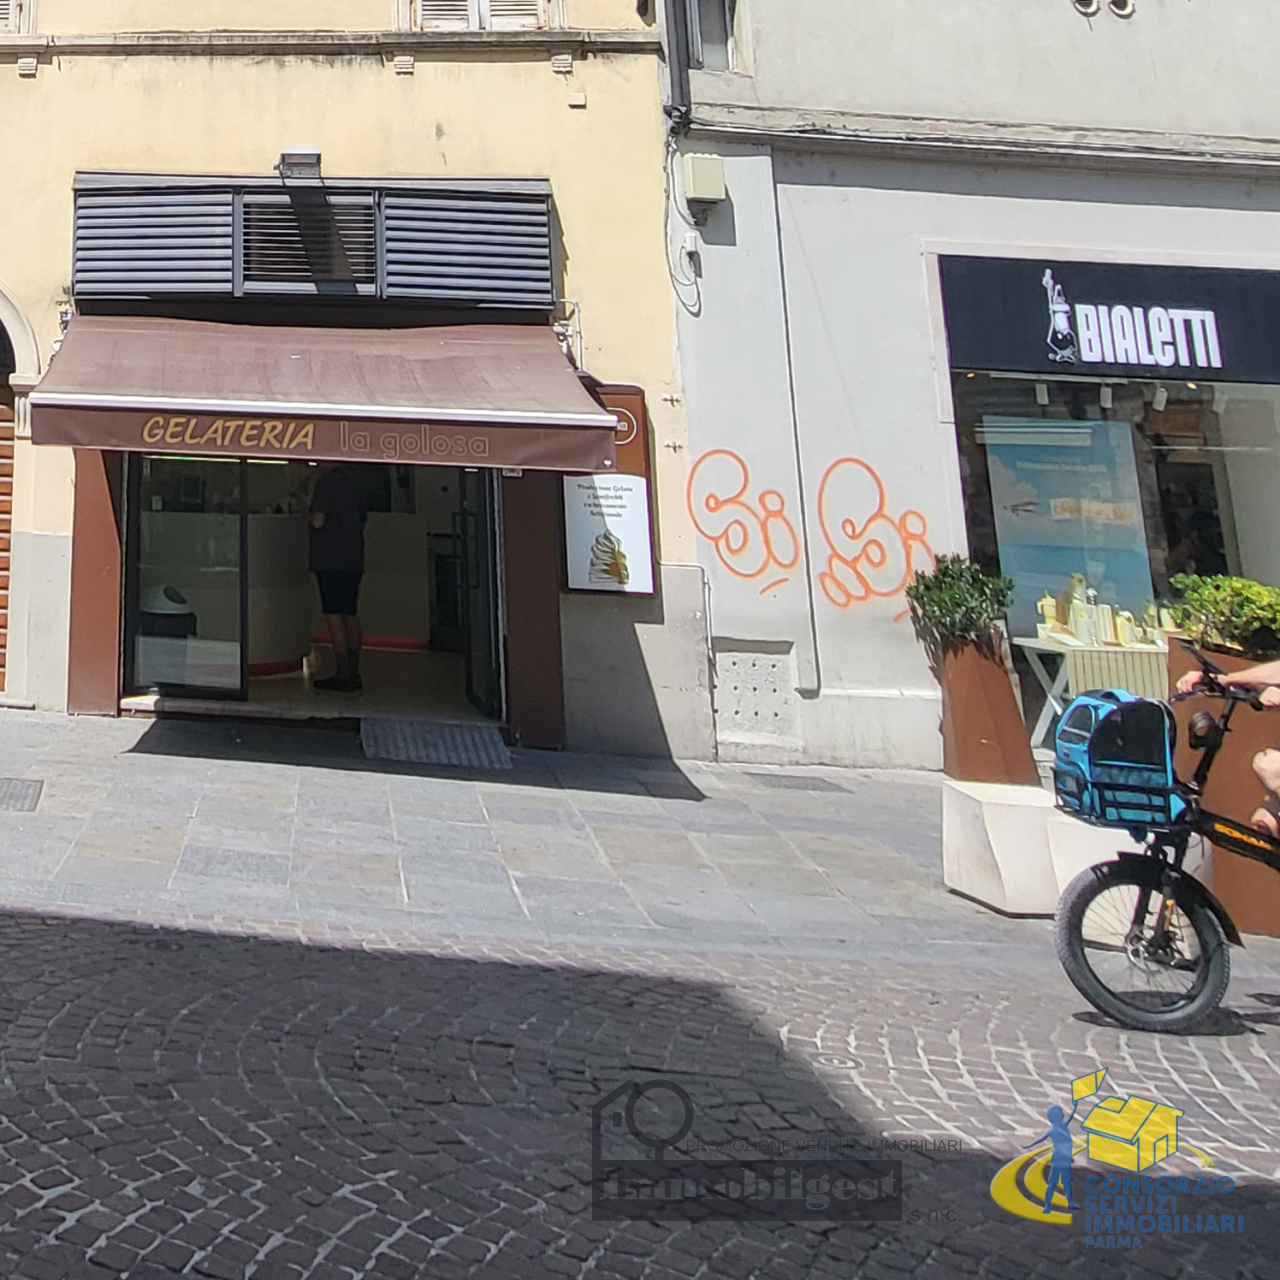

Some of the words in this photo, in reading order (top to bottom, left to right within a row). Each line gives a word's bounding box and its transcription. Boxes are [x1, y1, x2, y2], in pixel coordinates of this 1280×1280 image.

[142, 416, 315, 451] GELATERIA
[339, 420, 370, 452] la
[379, 424, 489, 459] golosa
